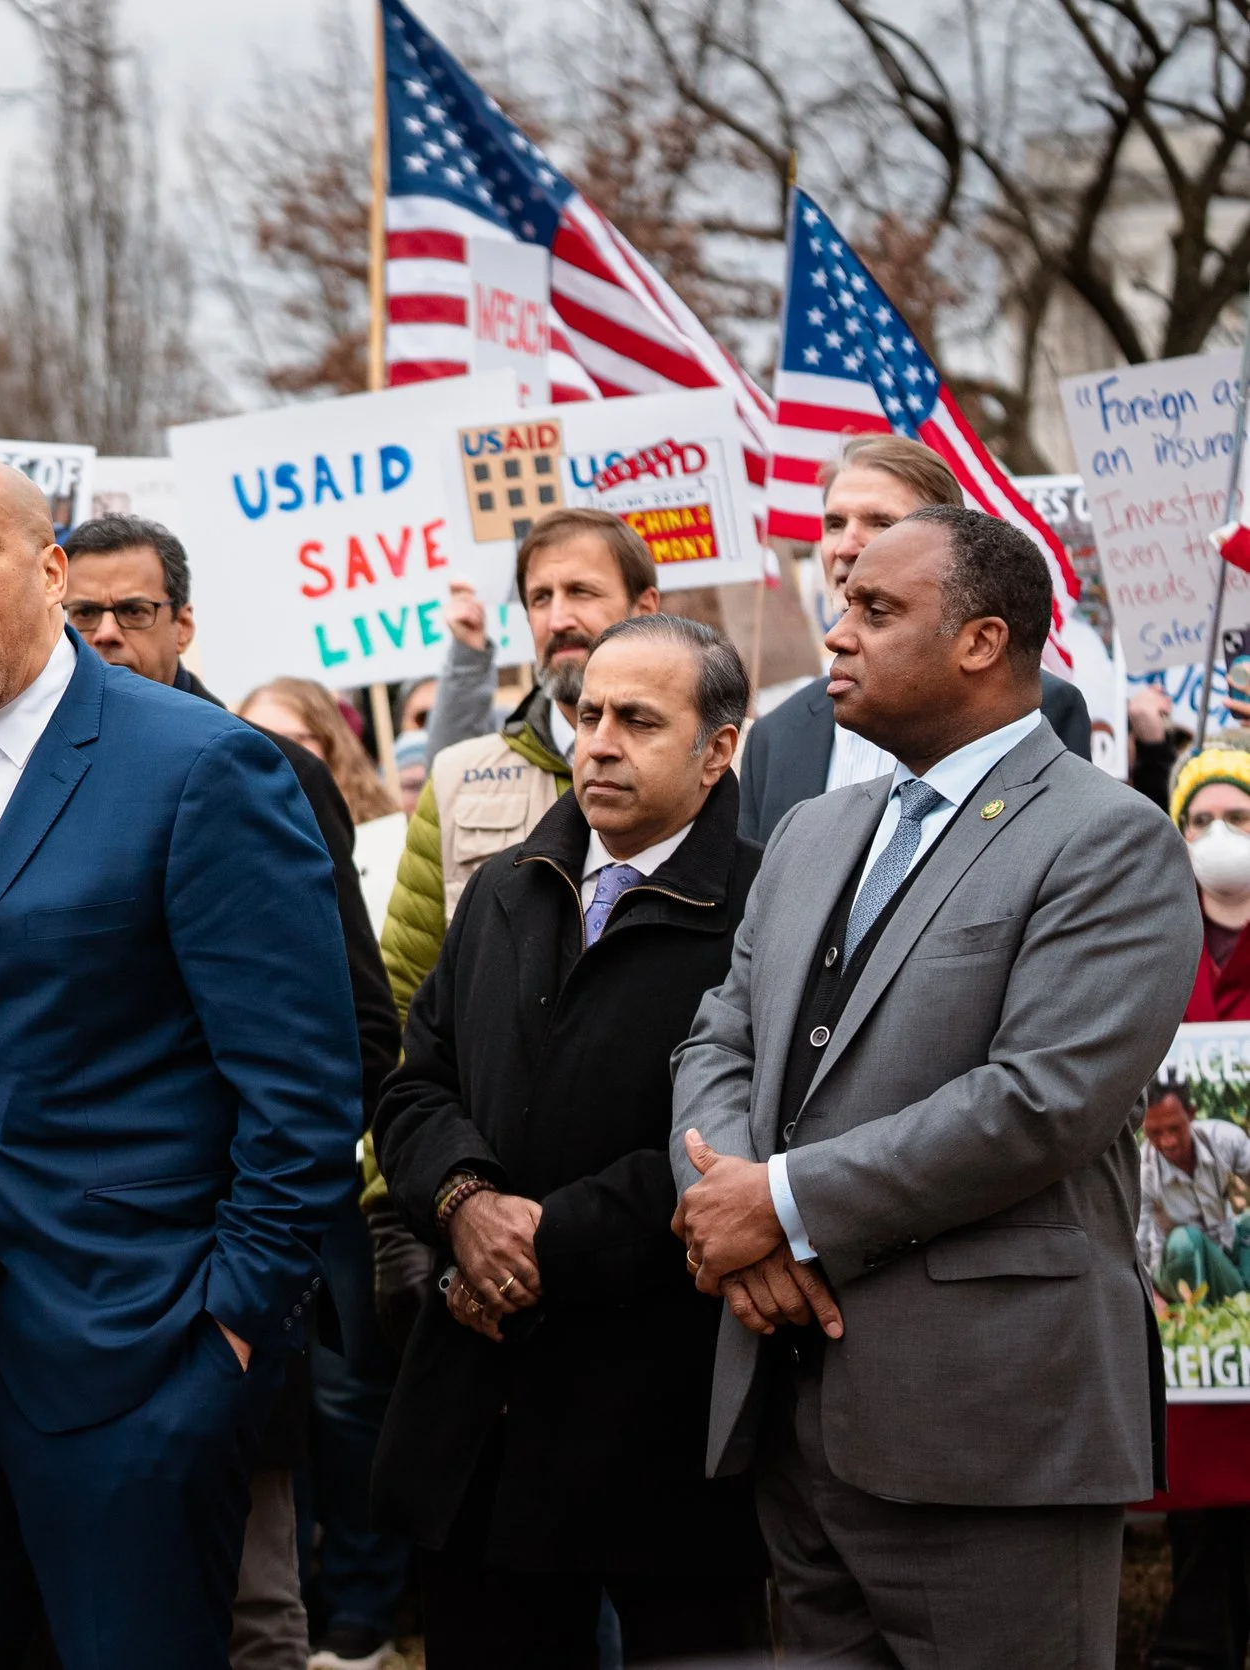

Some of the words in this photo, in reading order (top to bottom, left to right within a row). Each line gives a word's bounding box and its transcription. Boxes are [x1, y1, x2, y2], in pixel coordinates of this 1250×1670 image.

[463, 423, 559, 458] USAID
[1093, 446, 1134, 478] an
[1150, 431, 1236, 470] insura
[233, 445, 412, 521] USAID
[297, 518, 449, 600] SAVE
[1108, 541, 1169, 575] even
[1117, 568, 1198, 609] needs
[315, 600, 509, 668] LIVE!
[463, 765, 527, 784] DART
